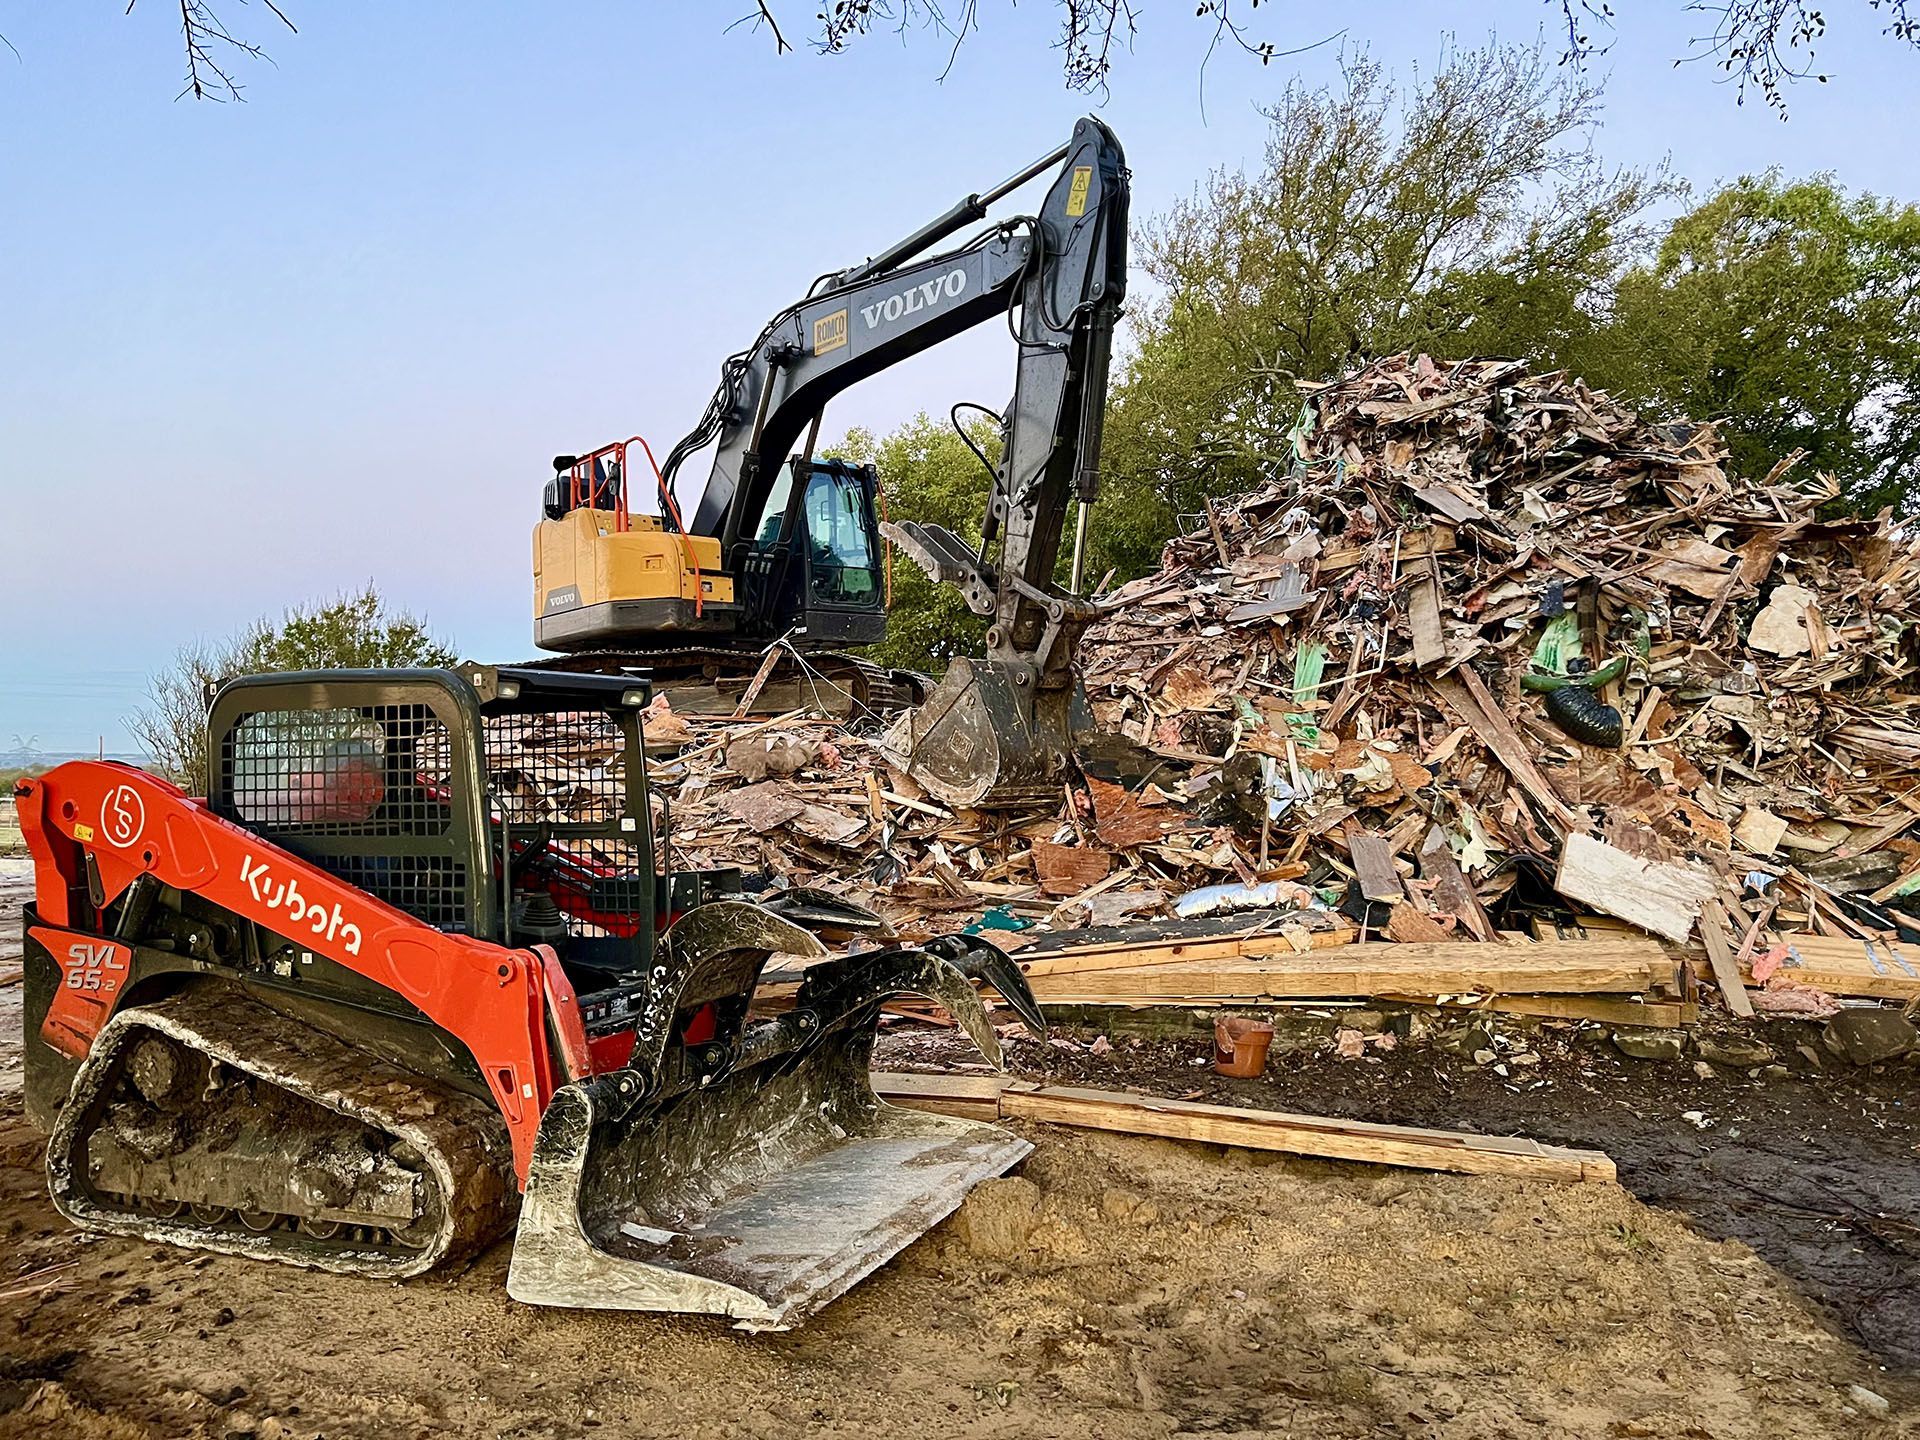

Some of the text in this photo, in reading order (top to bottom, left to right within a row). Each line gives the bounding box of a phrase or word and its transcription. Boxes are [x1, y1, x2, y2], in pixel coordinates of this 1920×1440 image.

[860, 269, 967, 329] VOLVO
[816, 314, 845, 344] ROMCO
[550, 592, 575, 607] VOLVO
[240, 854, 362, 956] Kubota
[65, 943, 125, 970] SVL
